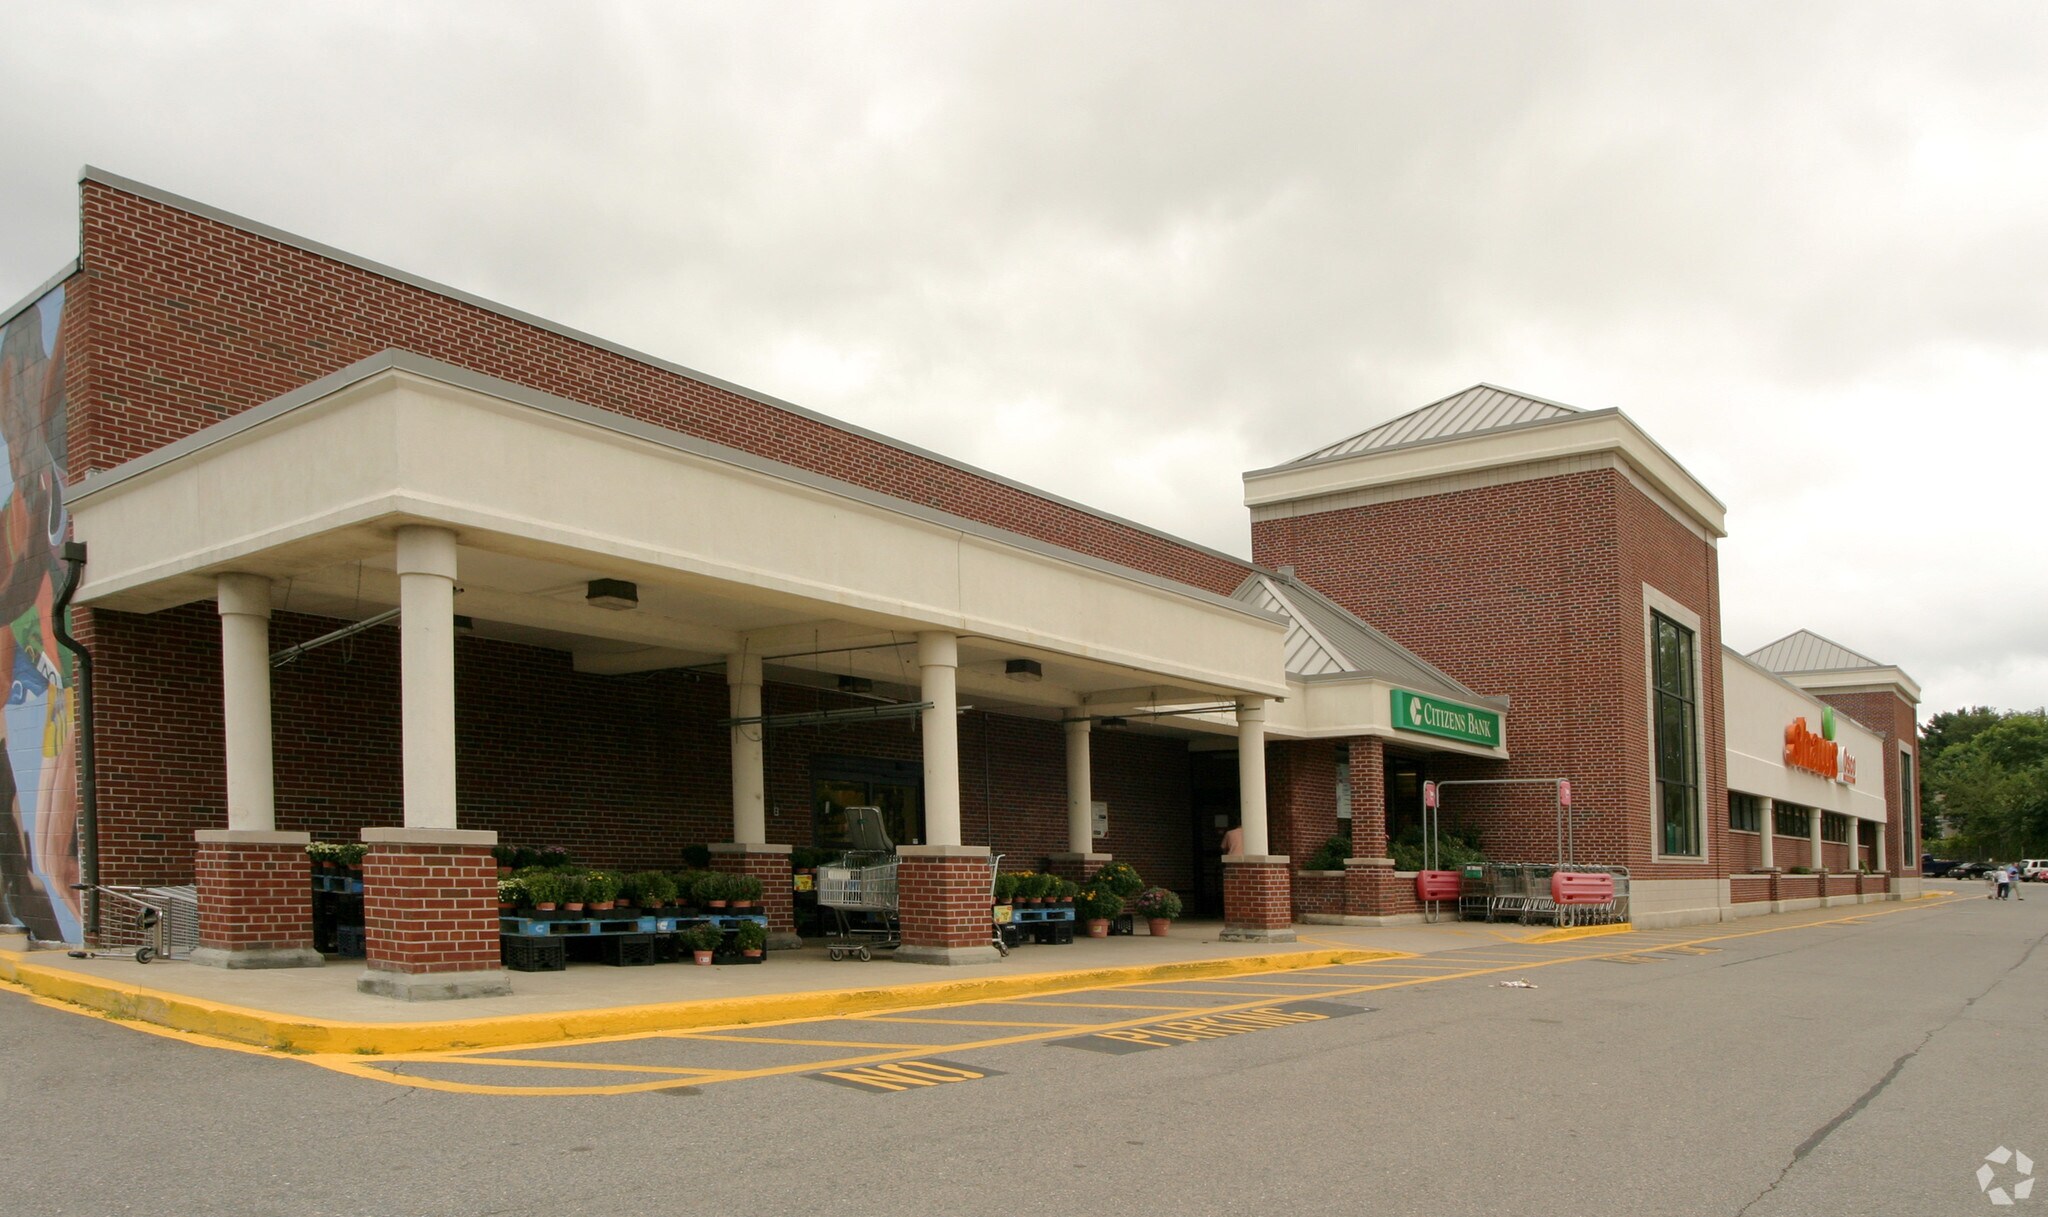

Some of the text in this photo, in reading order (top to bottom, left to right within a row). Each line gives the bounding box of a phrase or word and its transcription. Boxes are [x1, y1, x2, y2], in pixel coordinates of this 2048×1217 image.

[1424, 703, 1491, 738] CITIZENS BANK
[820, 1007, 1331, 1092] NO PARKING
